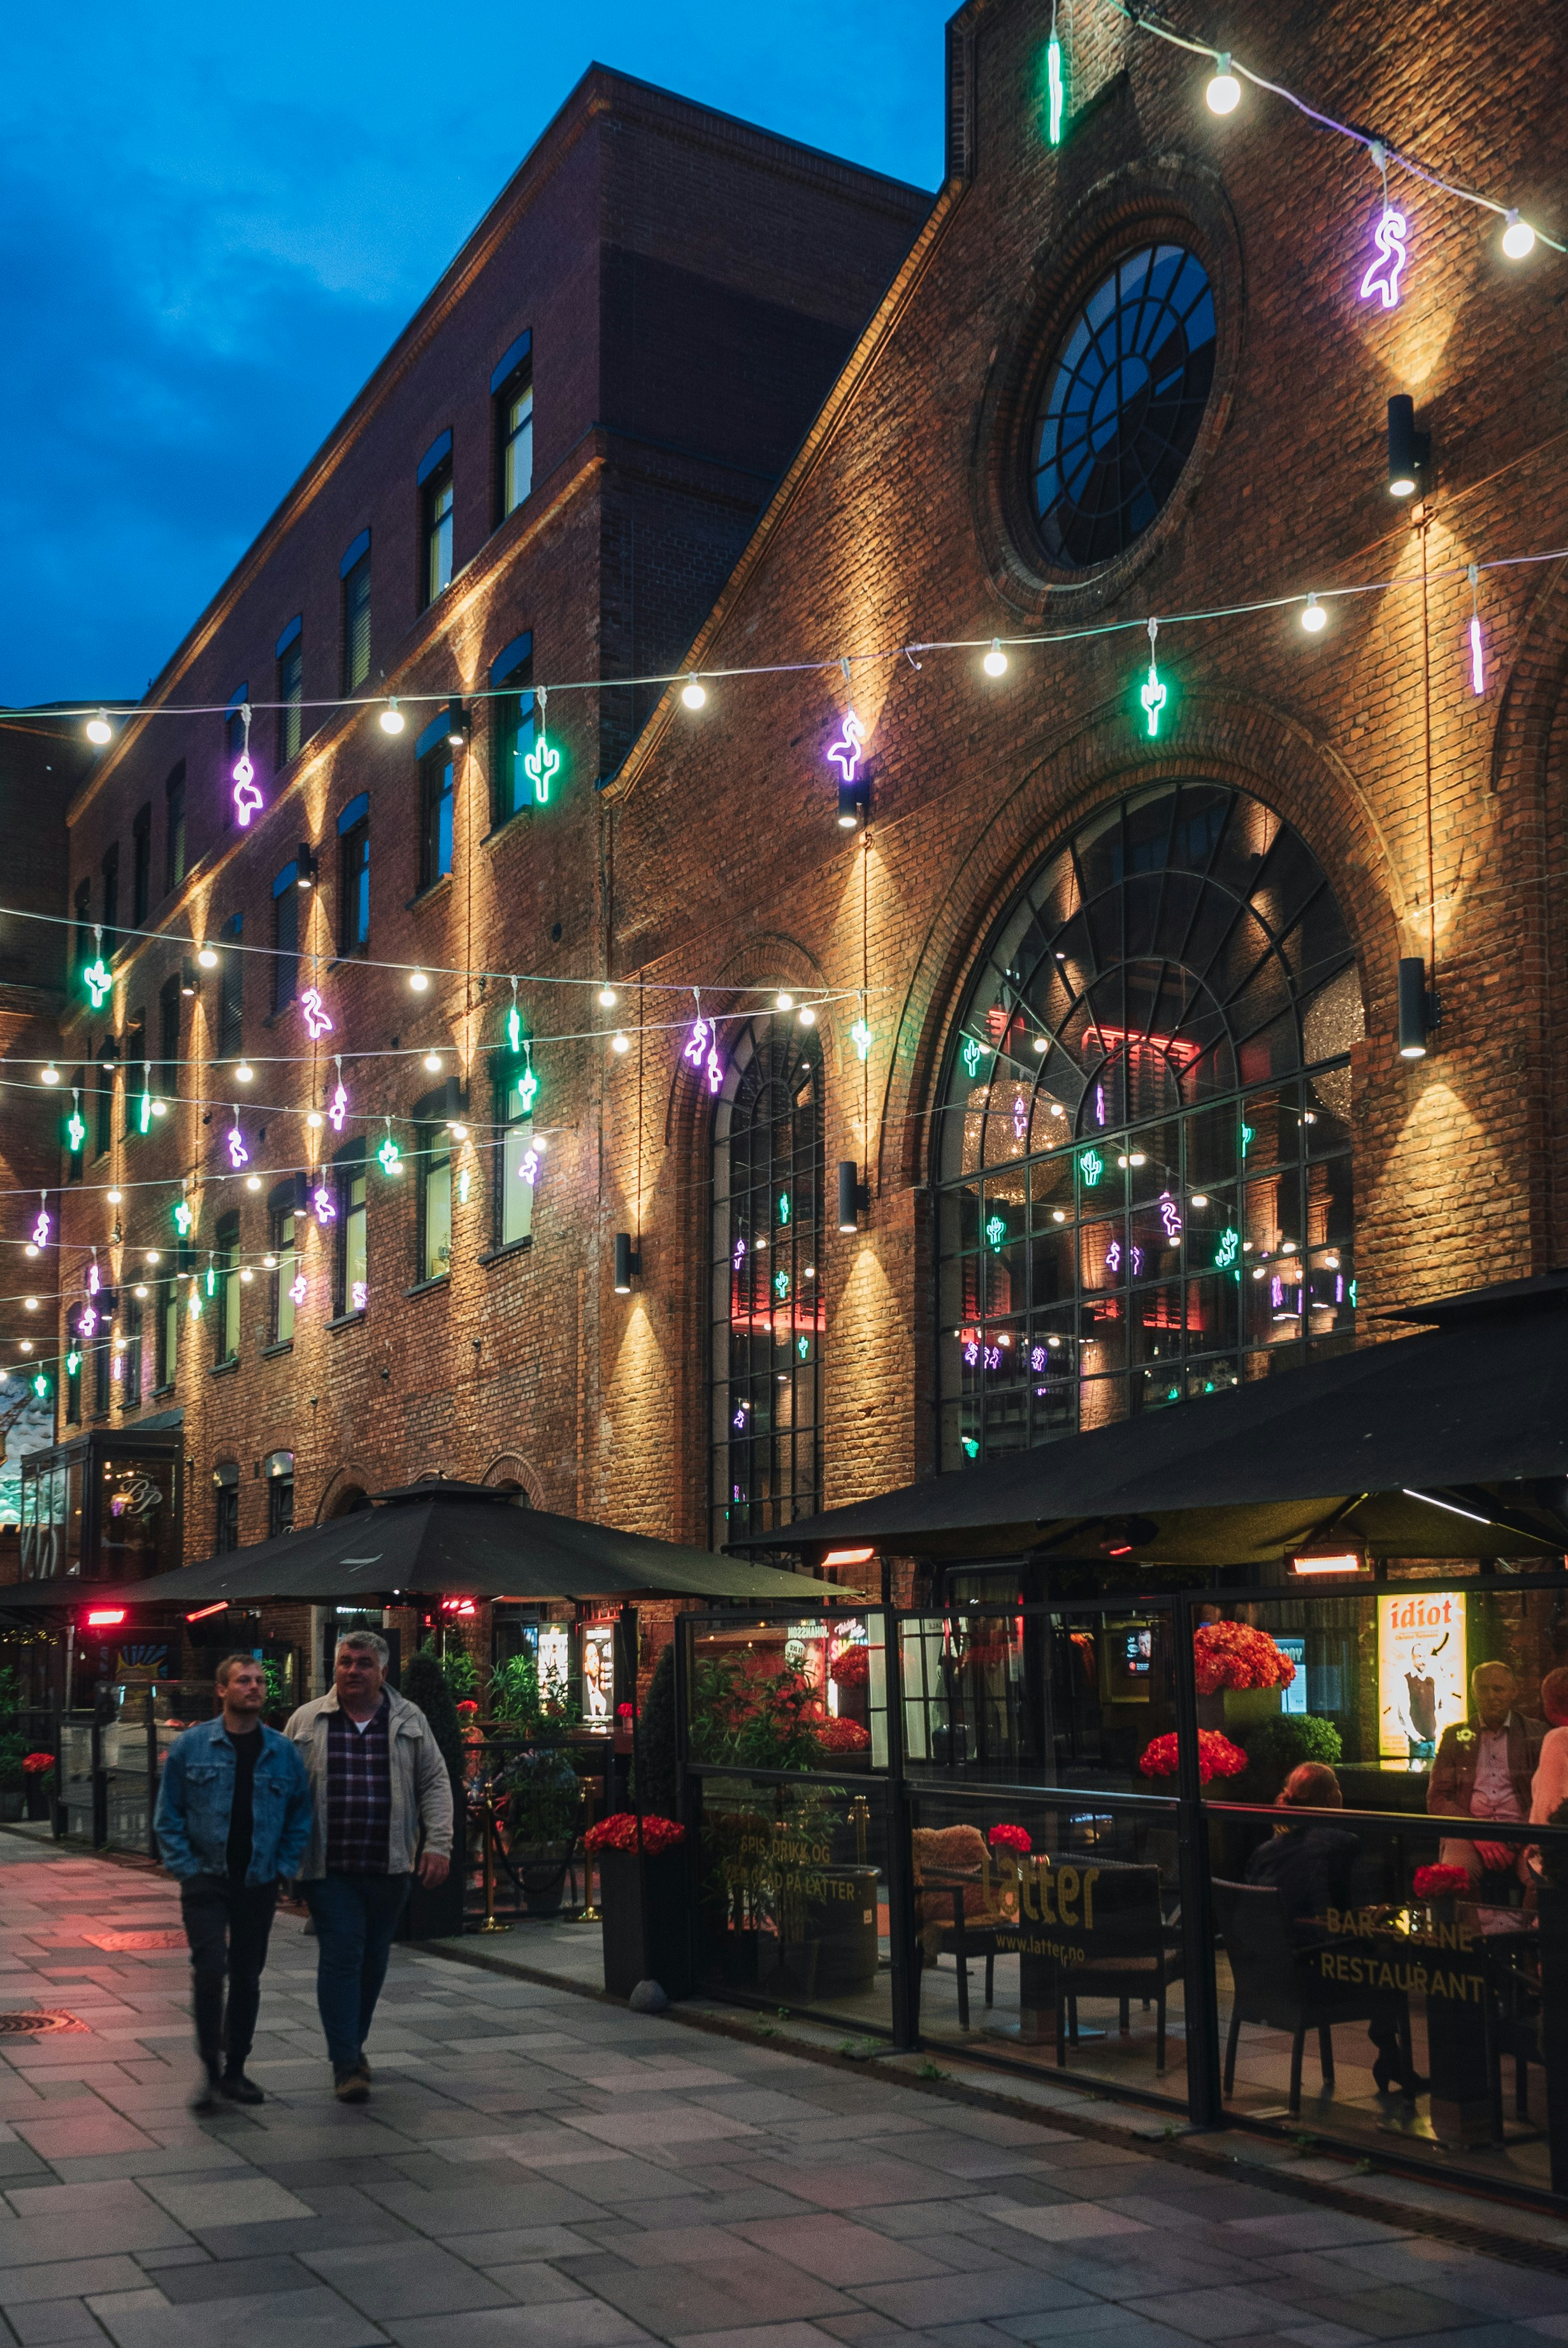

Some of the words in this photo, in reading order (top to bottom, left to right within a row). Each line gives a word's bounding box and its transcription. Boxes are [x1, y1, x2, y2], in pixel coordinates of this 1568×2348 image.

[1391, 1600, 1451, 1629] idiot
[812, 1845, 830, 1864] OG
[787, 1869, 803, 1892] PÅ
[805, 1876, 854, 1901] LATTER
[1327, 1906, 1374, 1938] BAR
[996, 1934, 1084, 1962] www.latter.no
[1321, 1952, 1485, 2003] RESTAURANT
